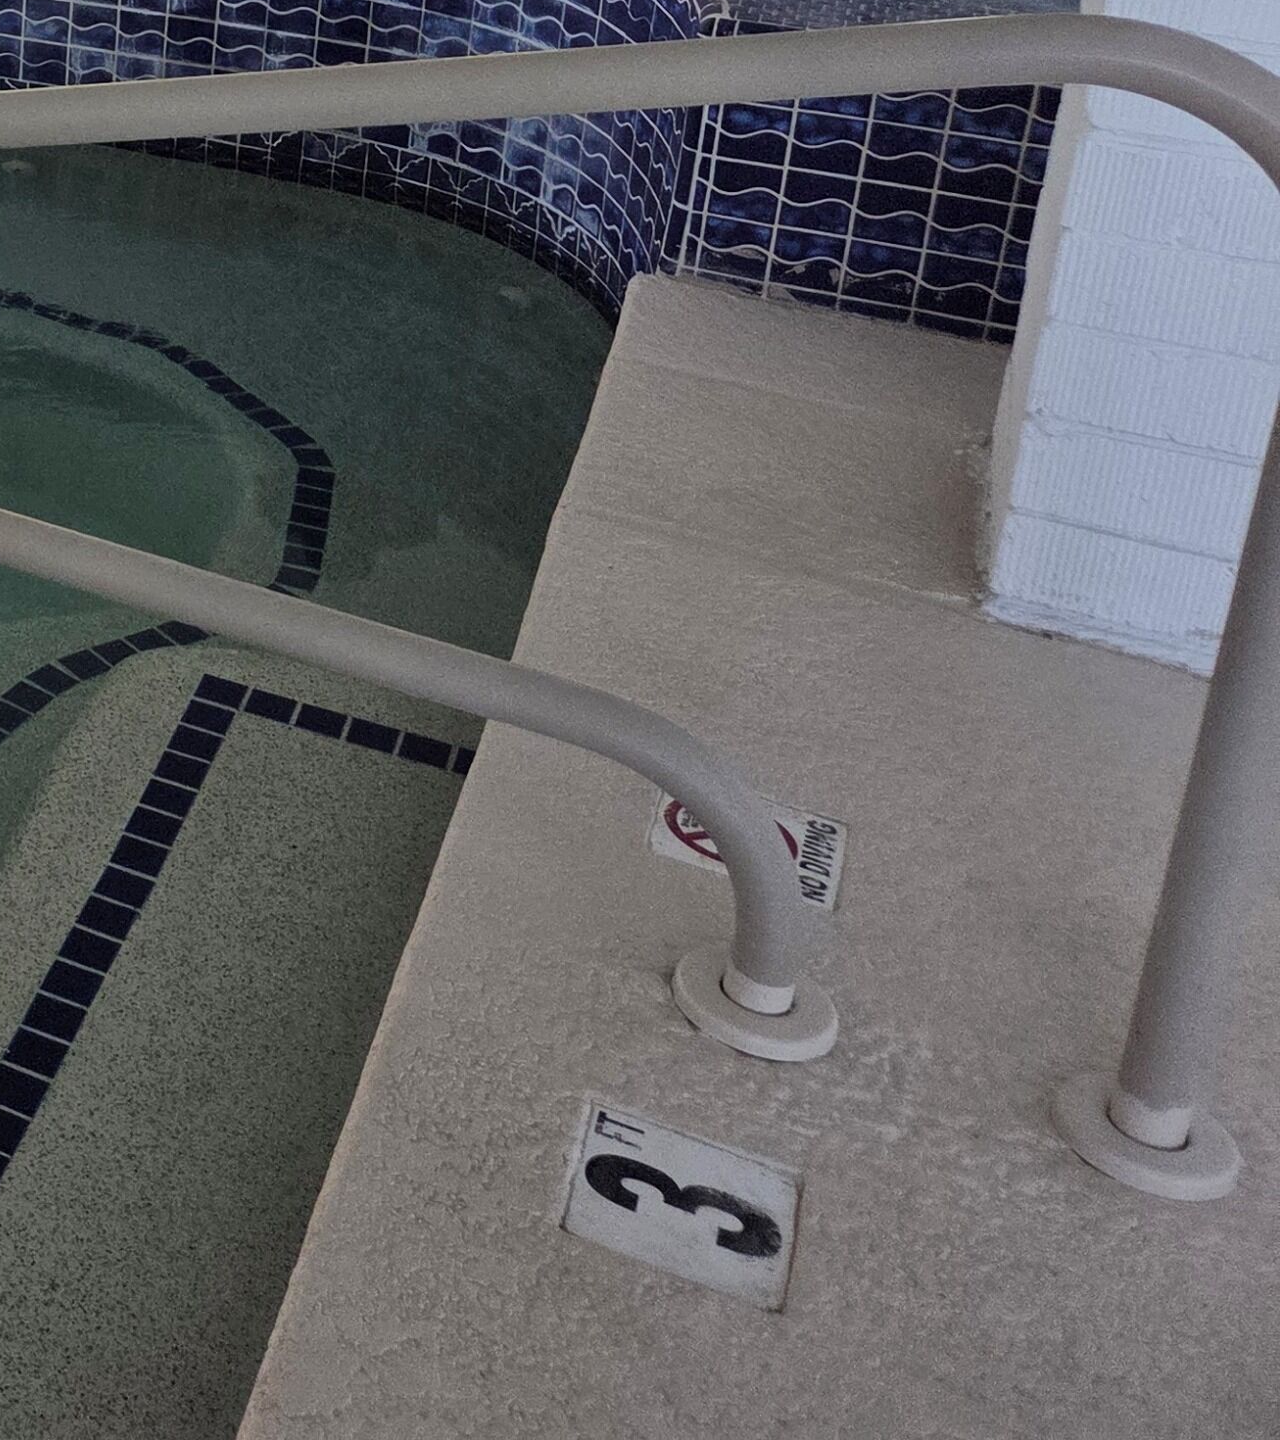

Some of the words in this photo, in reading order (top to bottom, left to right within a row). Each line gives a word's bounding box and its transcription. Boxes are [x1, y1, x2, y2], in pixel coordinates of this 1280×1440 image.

[799, 820, 838, 878] DIVING
[798, 875, 828, 904] NO
[594, 1110, 645, 1151] FT
[585, 1154, 782, 1257] 3
